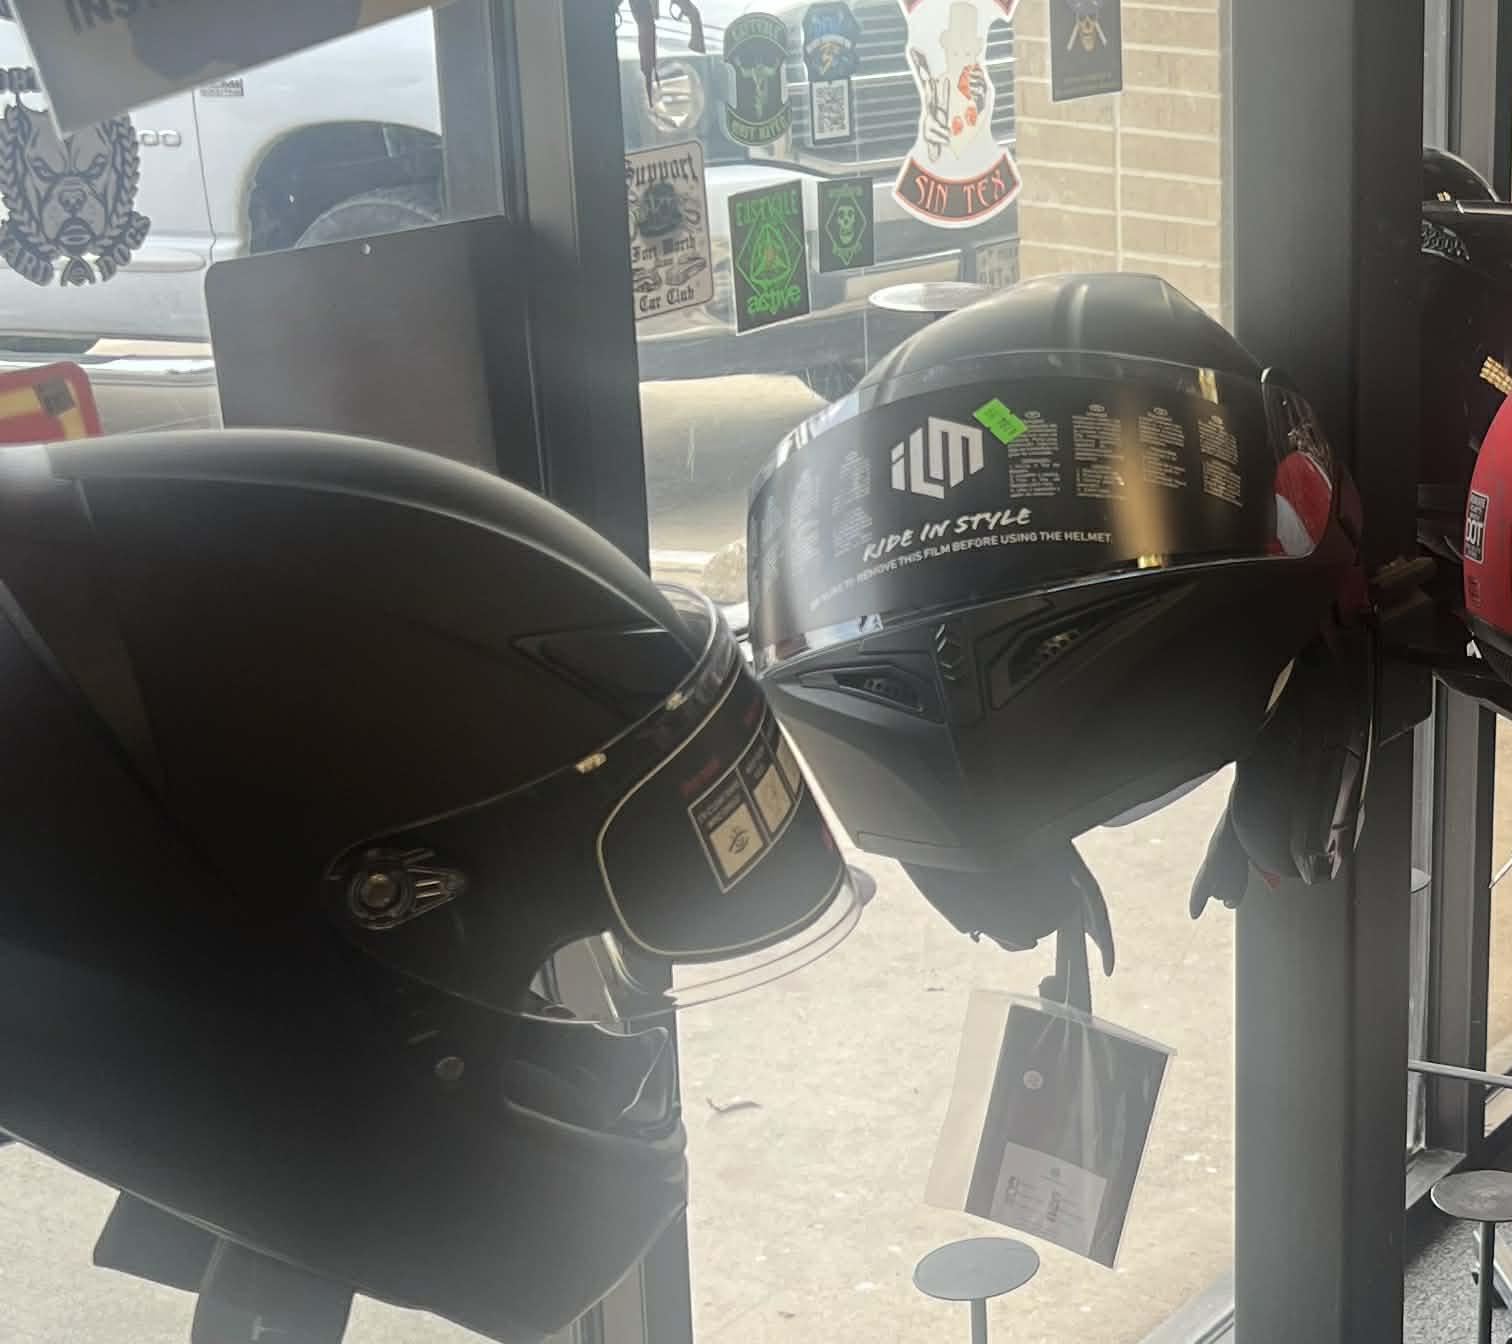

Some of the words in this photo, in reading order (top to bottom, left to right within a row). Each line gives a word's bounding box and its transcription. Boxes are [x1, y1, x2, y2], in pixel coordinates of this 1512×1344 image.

[625, 152, 699, 186] Support
[914, 174, 950, 212] SIN
[962, 170, 1007, 213] TEX
[638, 295, 661, 313] Car
[665, 286, 695, 306] Club
[862, 528, 914, 563] RIDE
[919, 519, 951, 541] IN
[953, 507, 1033, 535] STYLE
[856, 559, 898, 584] REMOVE
[899, 549, 923, 568] THIS
[923, 543, 951, 560] FILM
[952, 534, 999, 552] BEFORE
[1000, 532, 1037, 545] USING
[1039, 531, 1062, 543] THE
